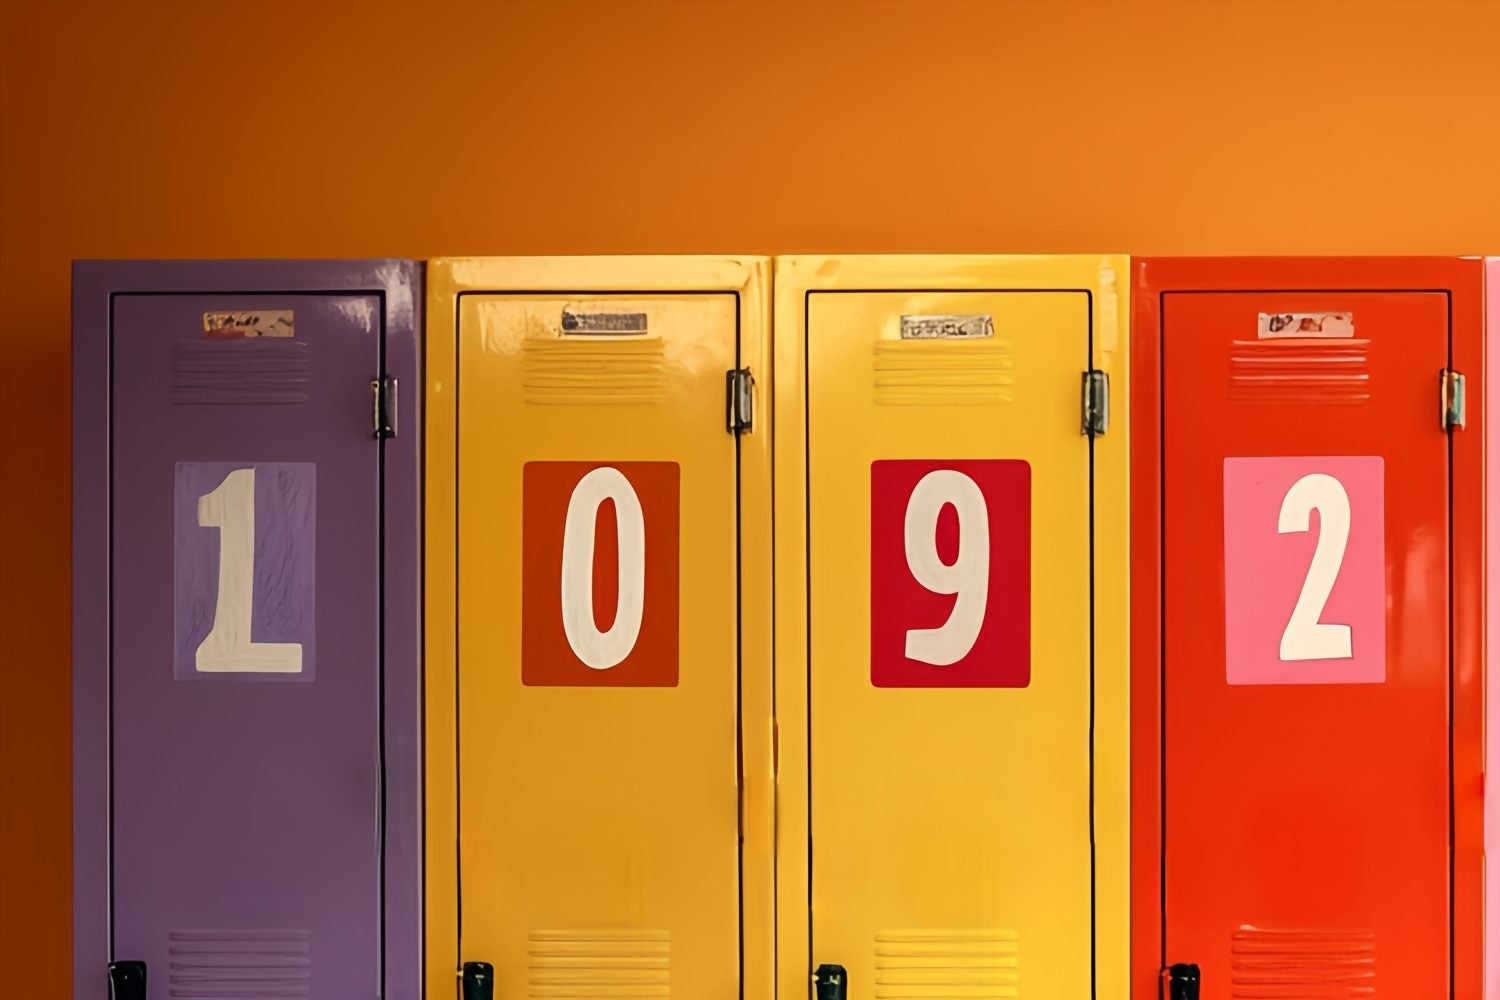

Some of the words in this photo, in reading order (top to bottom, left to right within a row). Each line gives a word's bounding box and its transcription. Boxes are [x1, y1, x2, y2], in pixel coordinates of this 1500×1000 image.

[195, 468, 303, 673] 1
[904, 470, 990, 666] 9
[1277, 473, 1353, 661] 2
